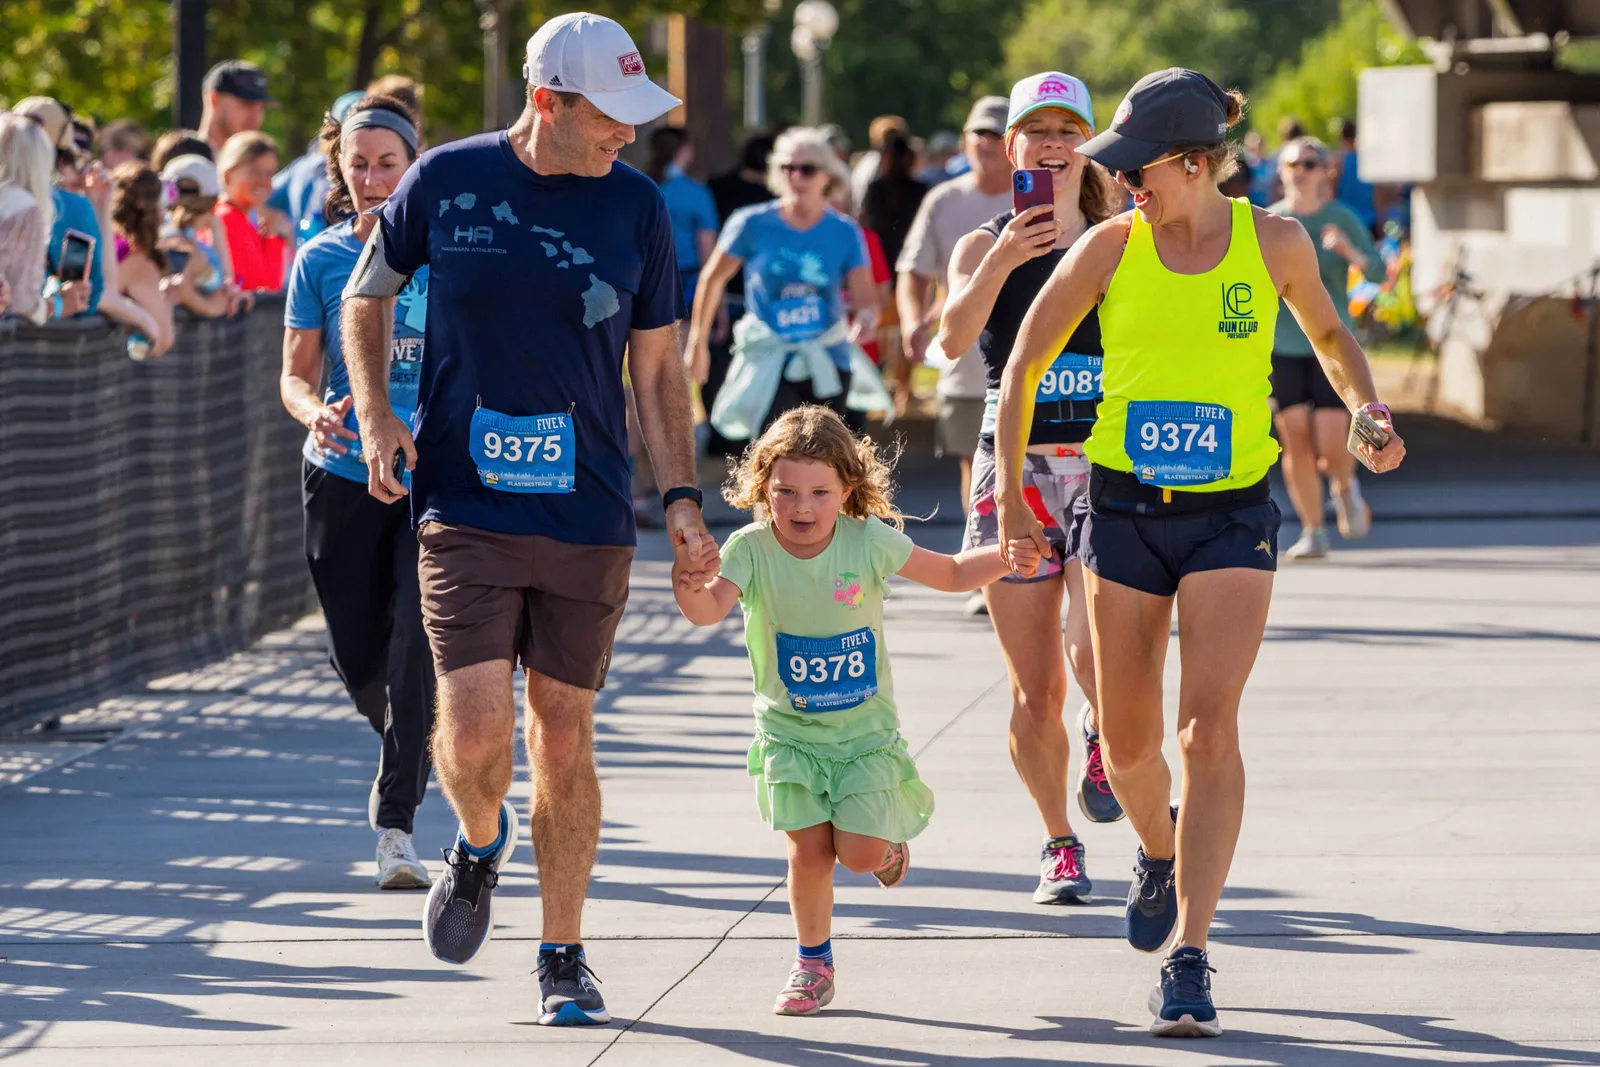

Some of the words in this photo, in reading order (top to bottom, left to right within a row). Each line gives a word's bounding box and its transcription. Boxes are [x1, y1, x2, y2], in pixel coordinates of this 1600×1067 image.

[454, 225, 494, 245] HA
[1218, 321, 1237, 333] RUN
[1239, 321, 1258, 333] CLUB
[1088, 356, 1104, 366] FIV
[1041, 369, 1104, 395] 9081
[483, 431, 562, 462] 9375
[1140, 421, 1218, 453] 9374
[789, 650, 866, 683] 9378
[816, 696, 860, 708] #LASTBESTRACE
